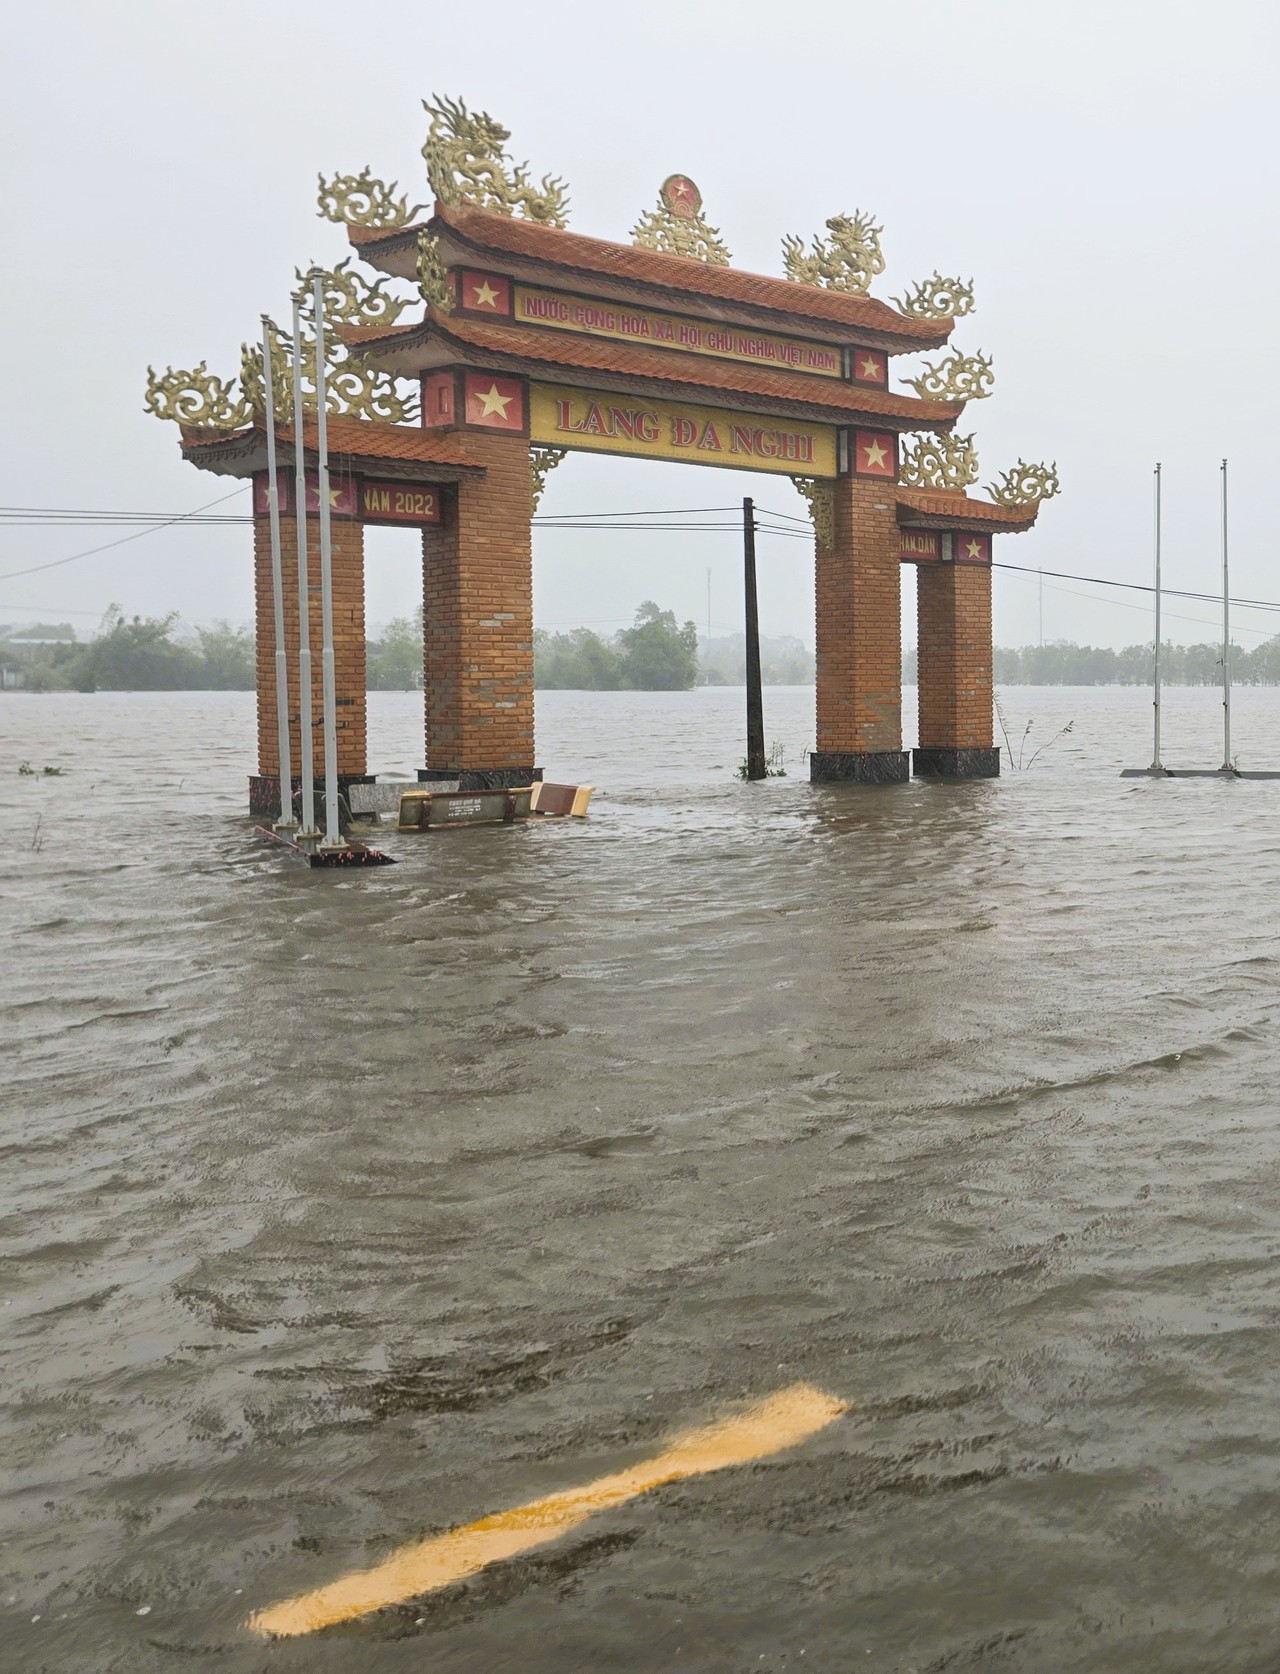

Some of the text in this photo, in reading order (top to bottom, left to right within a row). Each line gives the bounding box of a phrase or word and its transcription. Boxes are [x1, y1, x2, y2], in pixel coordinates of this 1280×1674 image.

[525, 296, 569, 321] NƯỚC
[655, 319, 675, 341] XÃ
[679, 325, 702, 348] HỘI
[707, 330, 734, 352] CHỦ
[737, 336, 776, 360] NGHĨA
[780, 343, 805, 366] VIỆT
[808, 349, 836, 371] NAM
[557, 397, 816, 463] LÀNG ĐA NGHI
[395, 492, 434, 515] 2022
